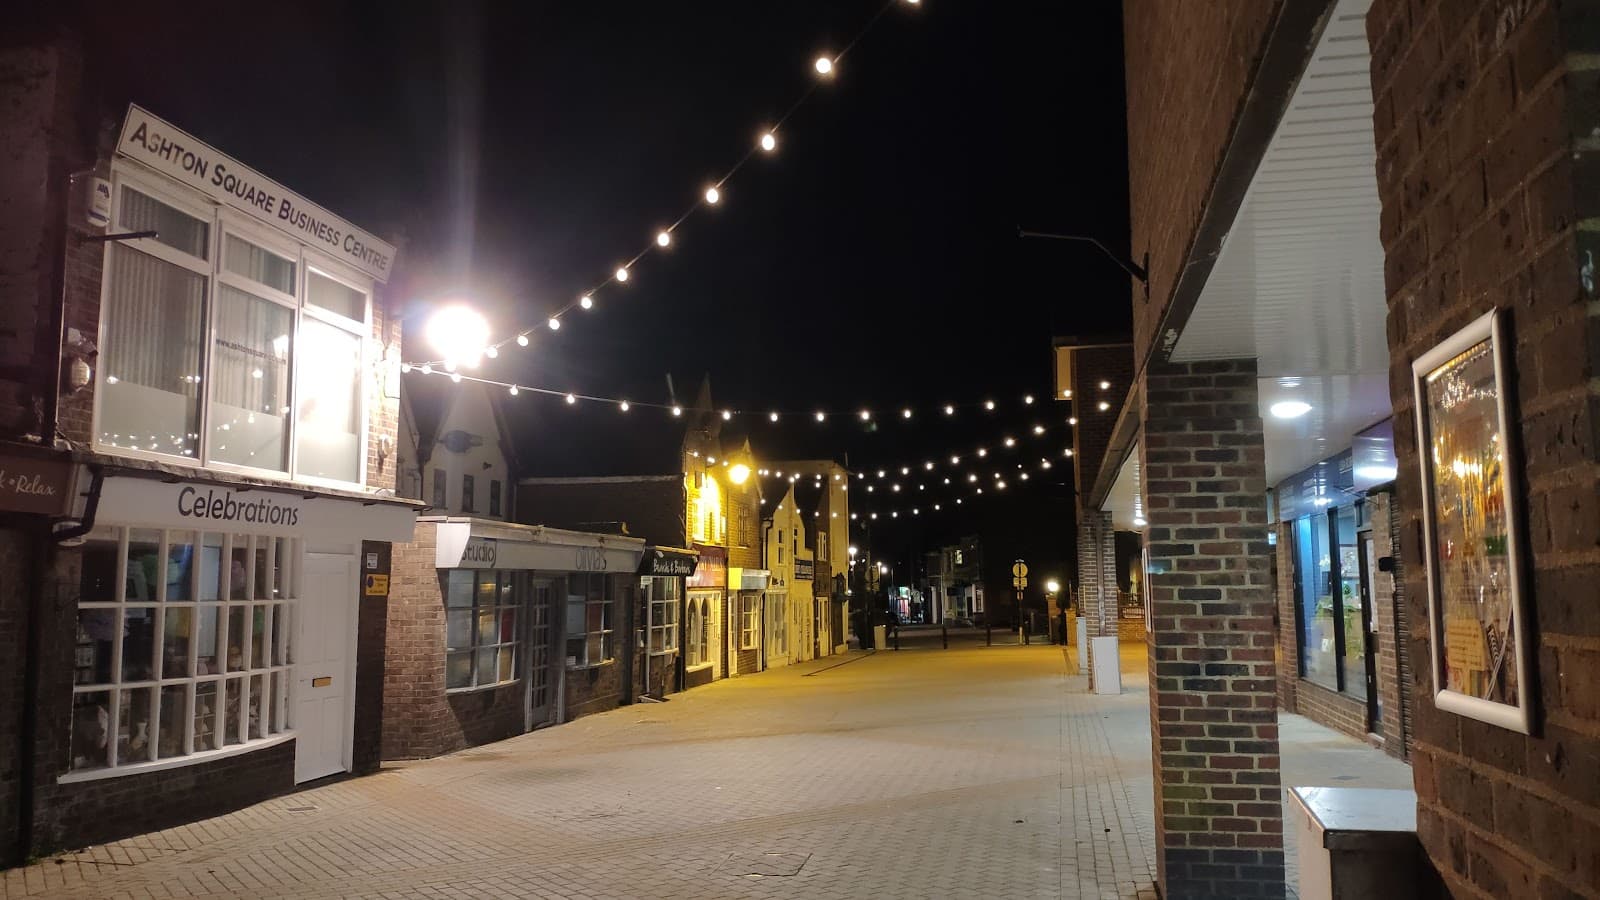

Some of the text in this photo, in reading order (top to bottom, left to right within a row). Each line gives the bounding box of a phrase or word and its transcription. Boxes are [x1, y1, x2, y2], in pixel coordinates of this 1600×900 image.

[130, 121, 388, 271] ASHTON SQUARE BUSINESS CENTRE
[15, 473, 57, 496] Relax
[178, 486, 299, 526] Celebrations
